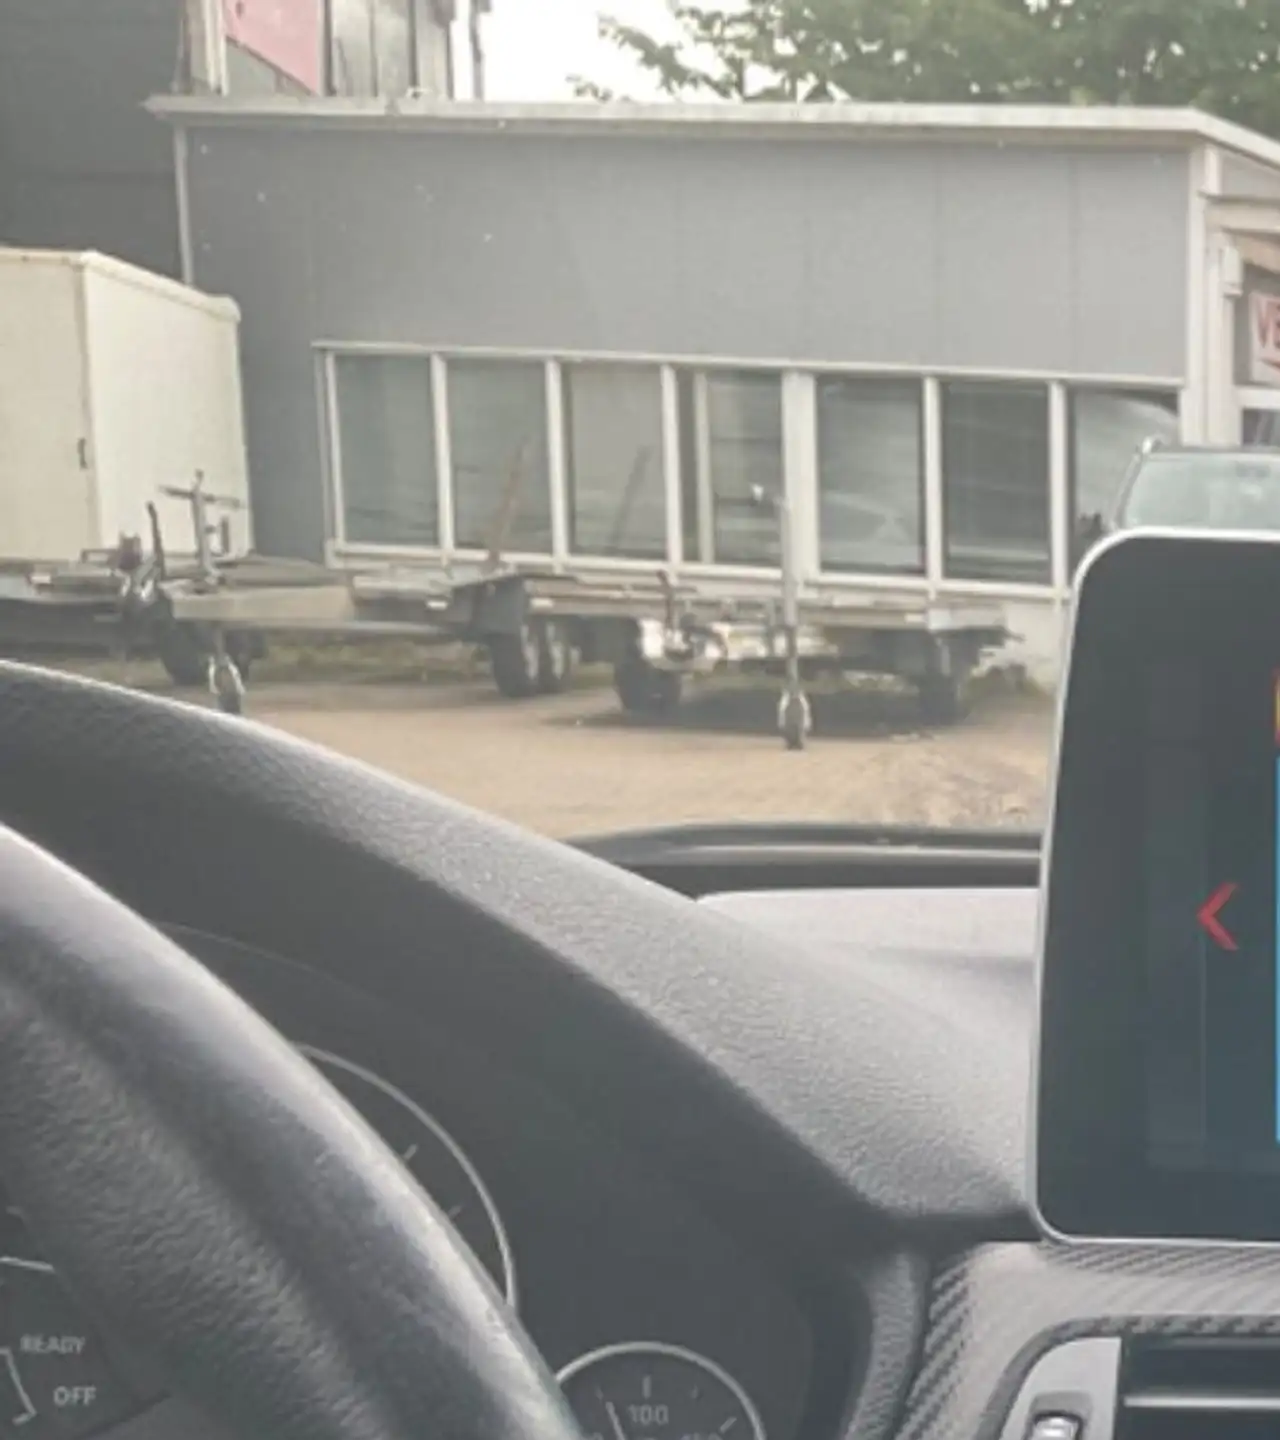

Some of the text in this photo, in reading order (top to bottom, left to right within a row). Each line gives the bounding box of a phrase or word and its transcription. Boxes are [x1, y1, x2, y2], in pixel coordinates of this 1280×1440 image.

[20, 1334, 85, 1354] READY
[53, 1386, 97, 1407] OFF
[628, 1404, 669, 1425] 100
